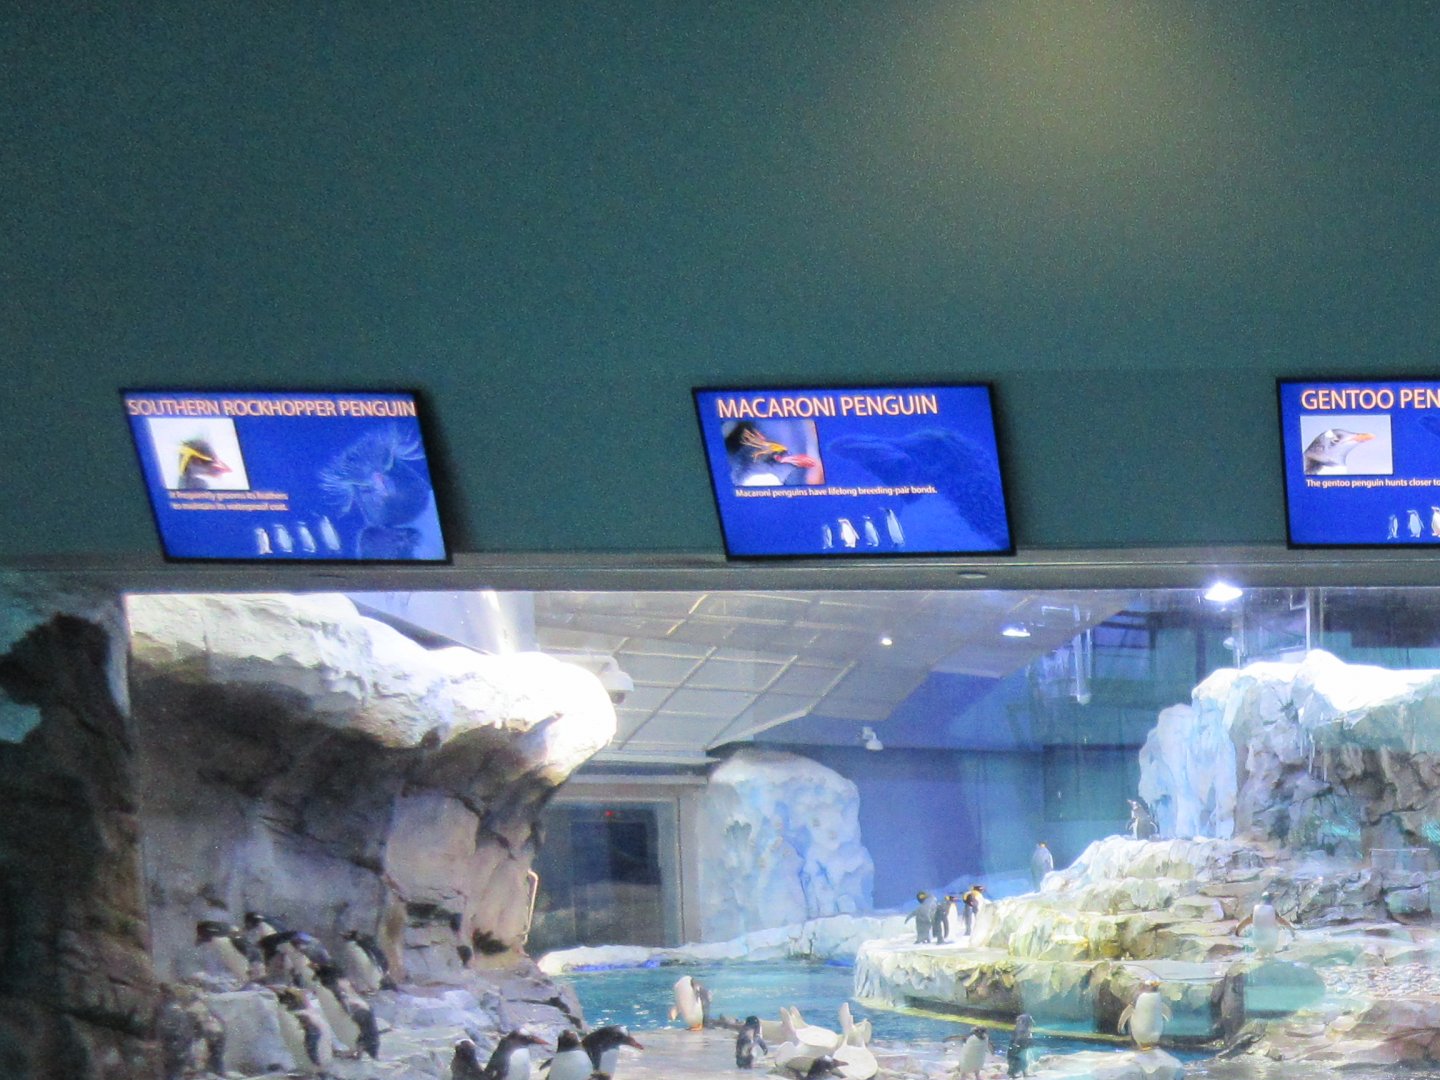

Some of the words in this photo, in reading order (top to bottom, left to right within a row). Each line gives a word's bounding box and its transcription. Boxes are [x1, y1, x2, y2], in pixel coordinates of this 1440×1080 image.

[717, 397, 836, 418] MACARONI
[840, 394, 938, 416] PENGUIN
[1301, 389, 1394, 410] GENTOO
[128, 400, 221, 416] SOUTHERN
[223, 401, 338, 416] ROCKHOPPER
[340, 401, 417, 417] PENGUIN
[1306, 478, 1320, 487] The
[1321, 479, 1350, 489] gentoo
[1351, 478, 1384, 489] penguin
[1385, 478, 1408, 487] hunts
[1408, 477, 1432, 487] closer
[735, 488, 771, 498] Macaroni
[772, 488, 809, 499] penguins
[809, 488, 827, 497] have
[828, 487, 857, 498] lifelong
[858, 486, 909, 497] breeding-pair
[911, 485, 938, 495] bonds.
